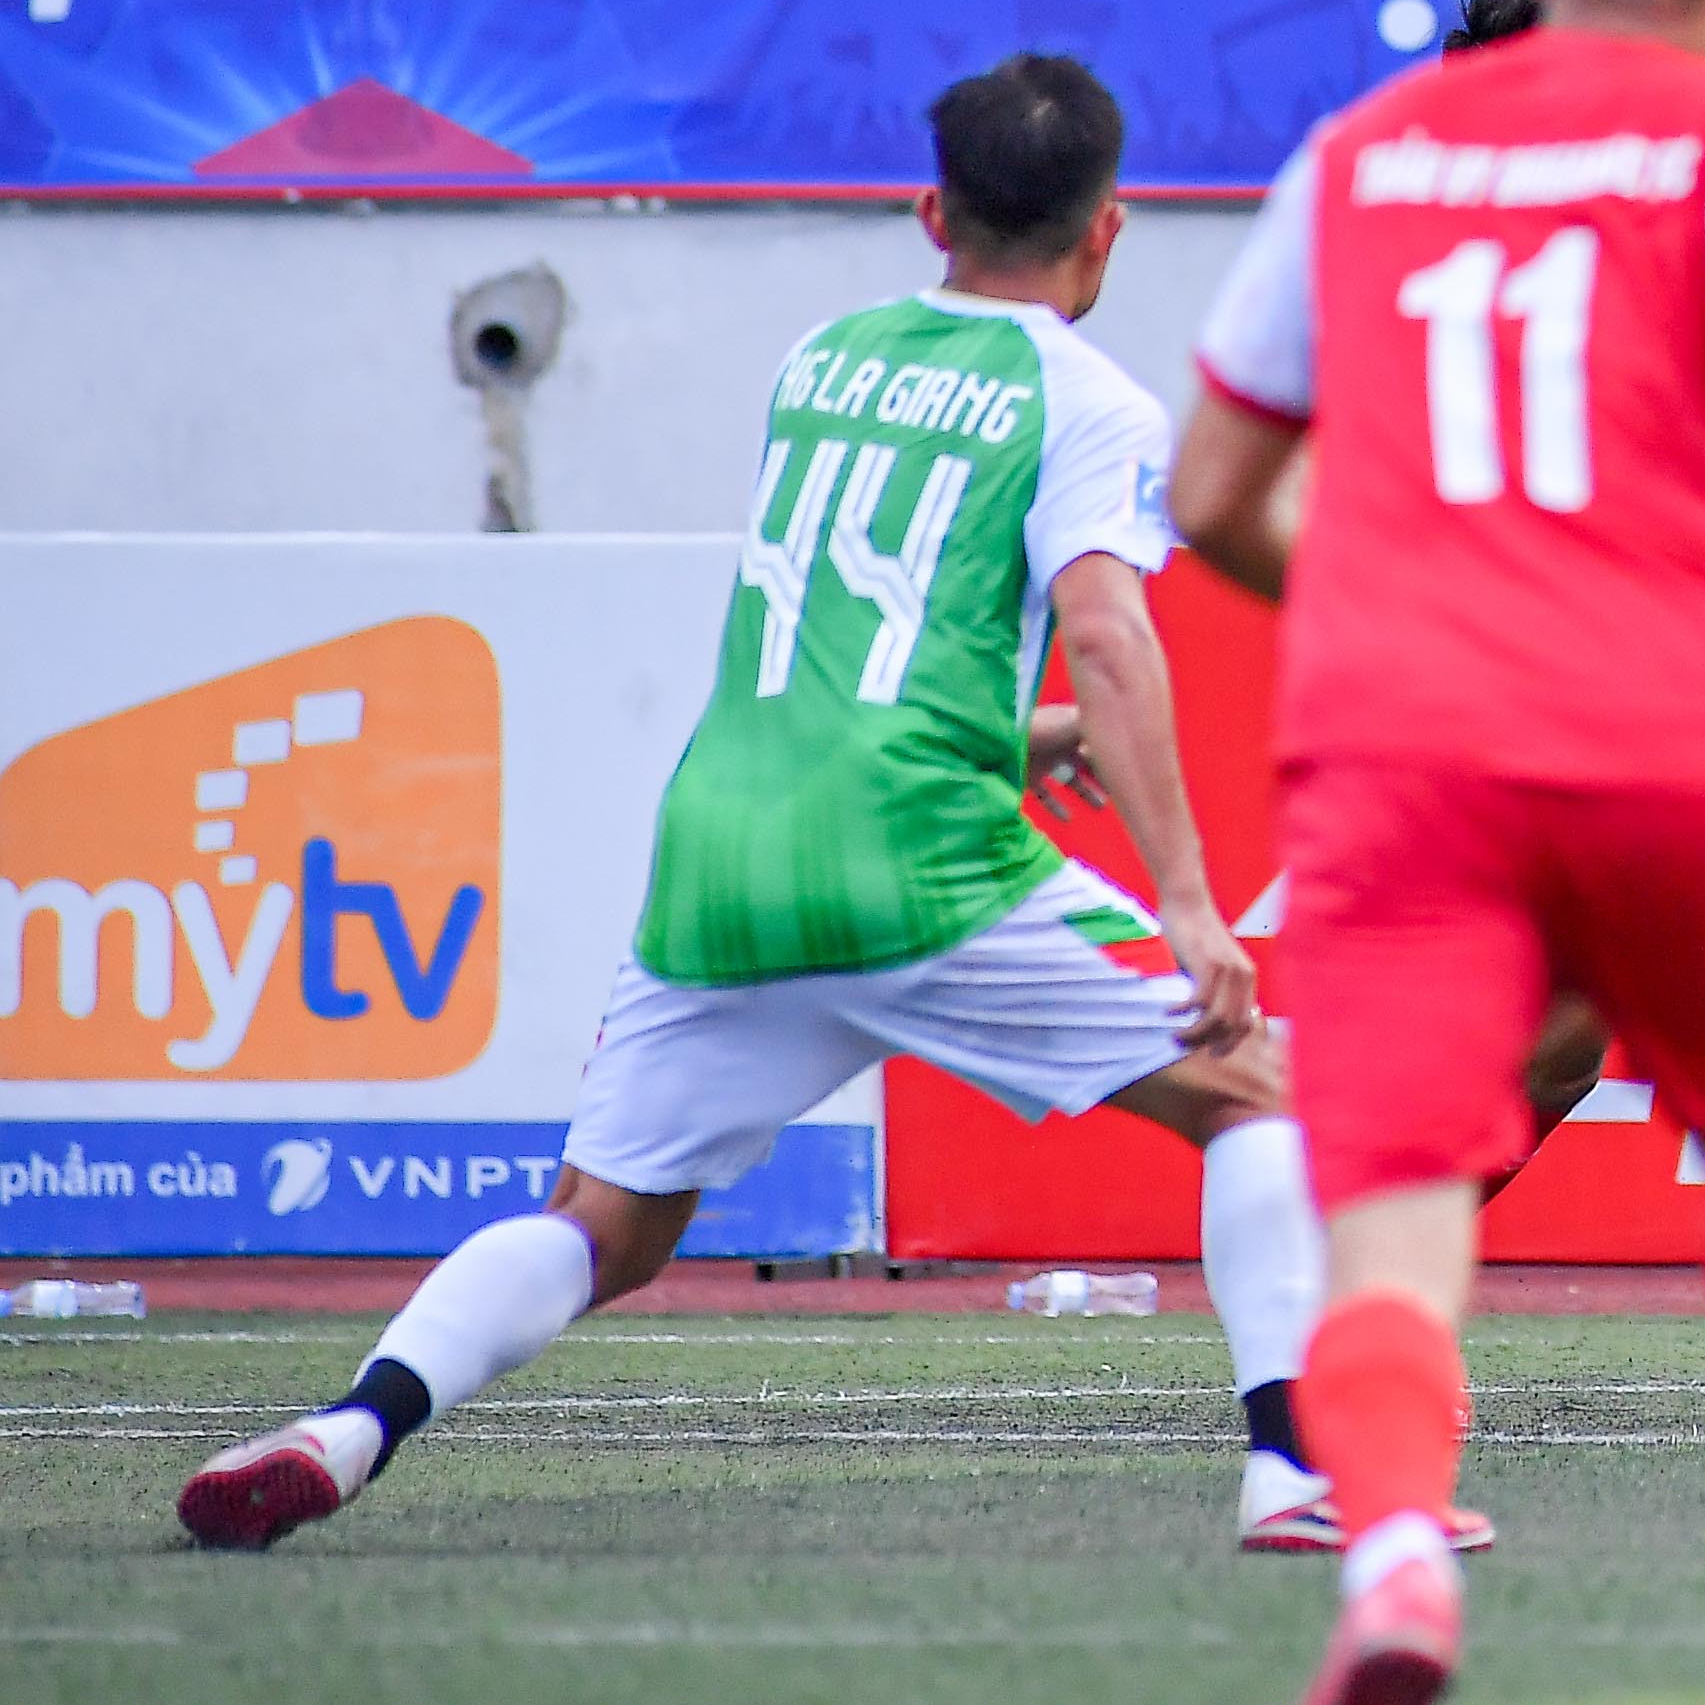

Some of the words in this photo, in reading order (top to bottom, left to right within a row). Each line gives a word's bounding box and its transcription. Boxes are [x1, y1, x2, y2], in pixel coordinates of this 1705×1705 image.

[811, 352, 888, 419] LA
[876, 361, 1034, 444] GIANG
[1397, 225, 1599, 513] 11
[740, 437, 972, 706] 44
[0, 836, 485, 1072] mytv
[147, 1150, 238, 1198] của
[348, 1154, 559, 1200] VNPT
